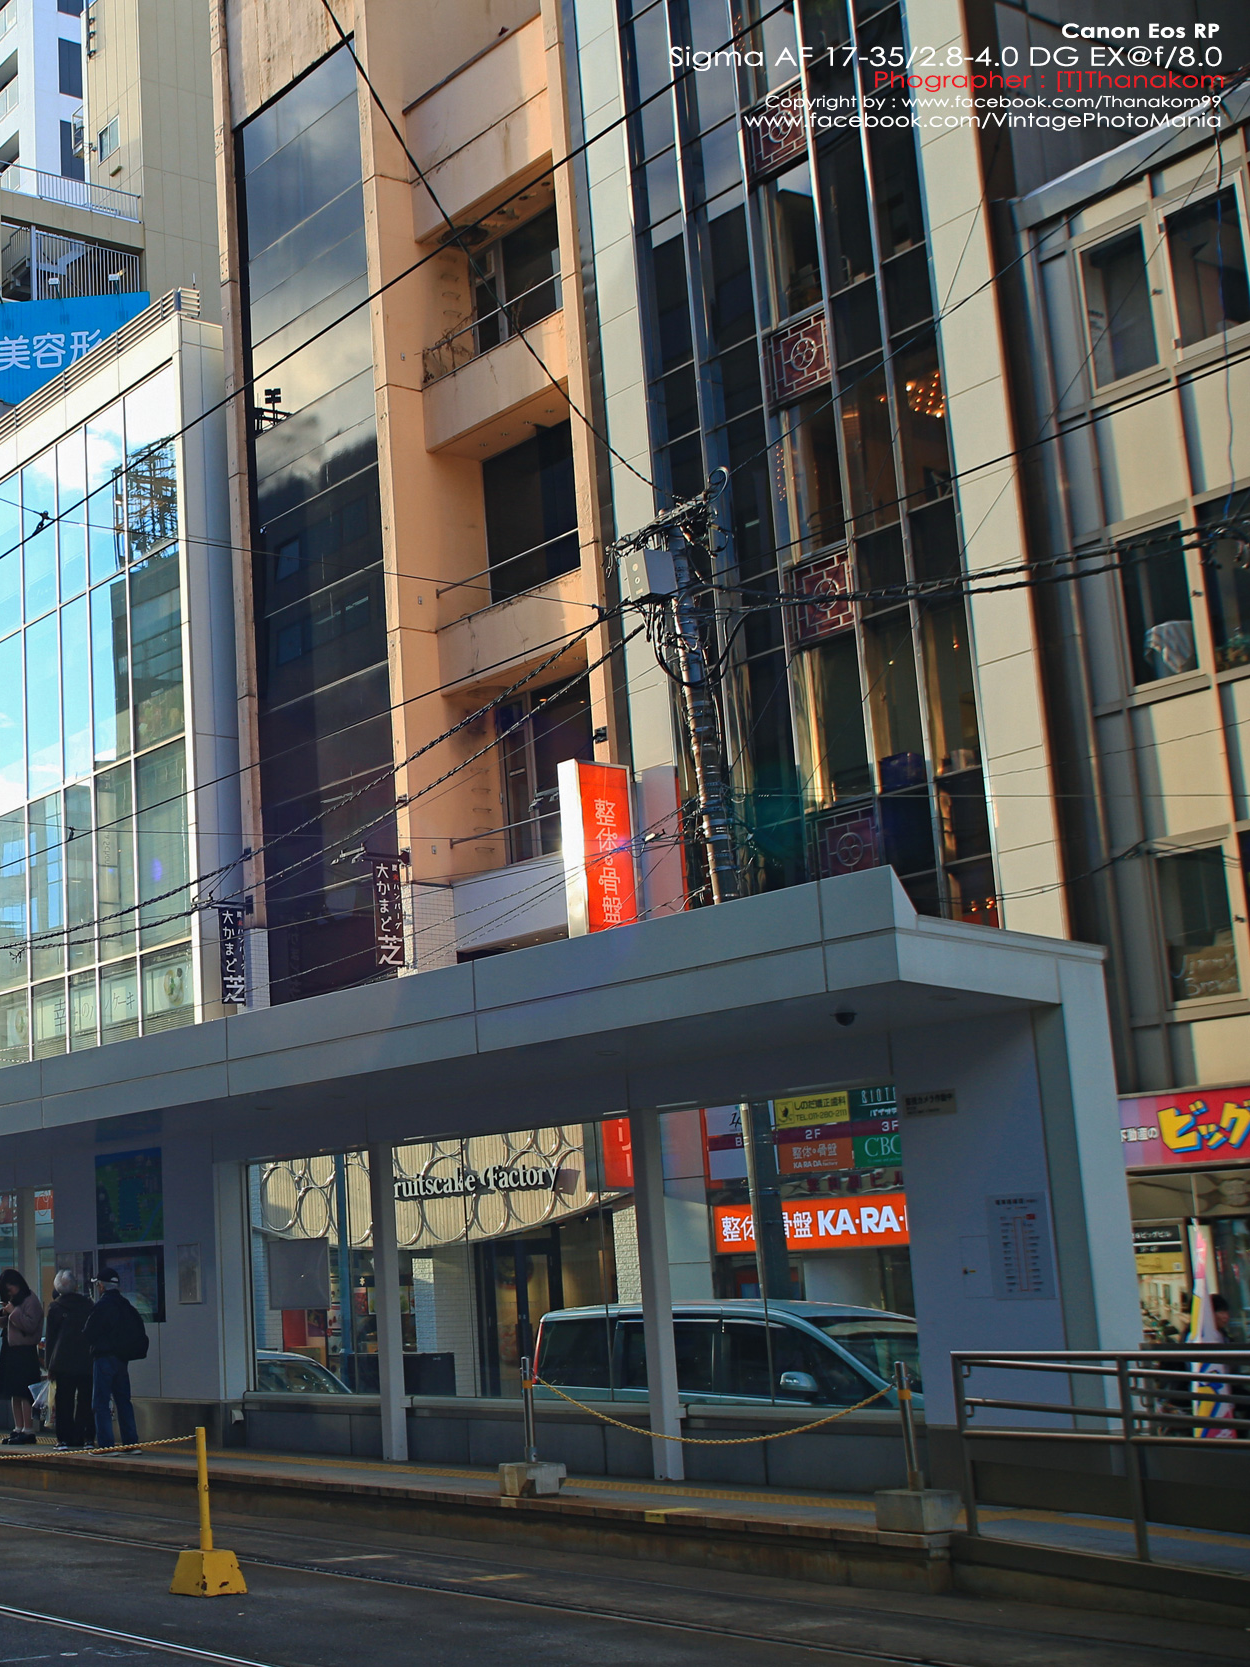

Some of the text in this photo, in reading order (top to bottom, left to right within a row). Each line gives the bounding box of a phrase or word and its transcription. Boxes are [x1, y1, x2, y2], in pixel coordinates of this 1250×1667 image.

[375, 863, 404, 965] 大かまど芝
[222, 910, 245, 1003] 大かまど芝
[805, 1128, 822, 1141] 2F
[881, 1120, 899, 1132] 3F
[393, 1163, 562, 1199] ruitscake Factory
